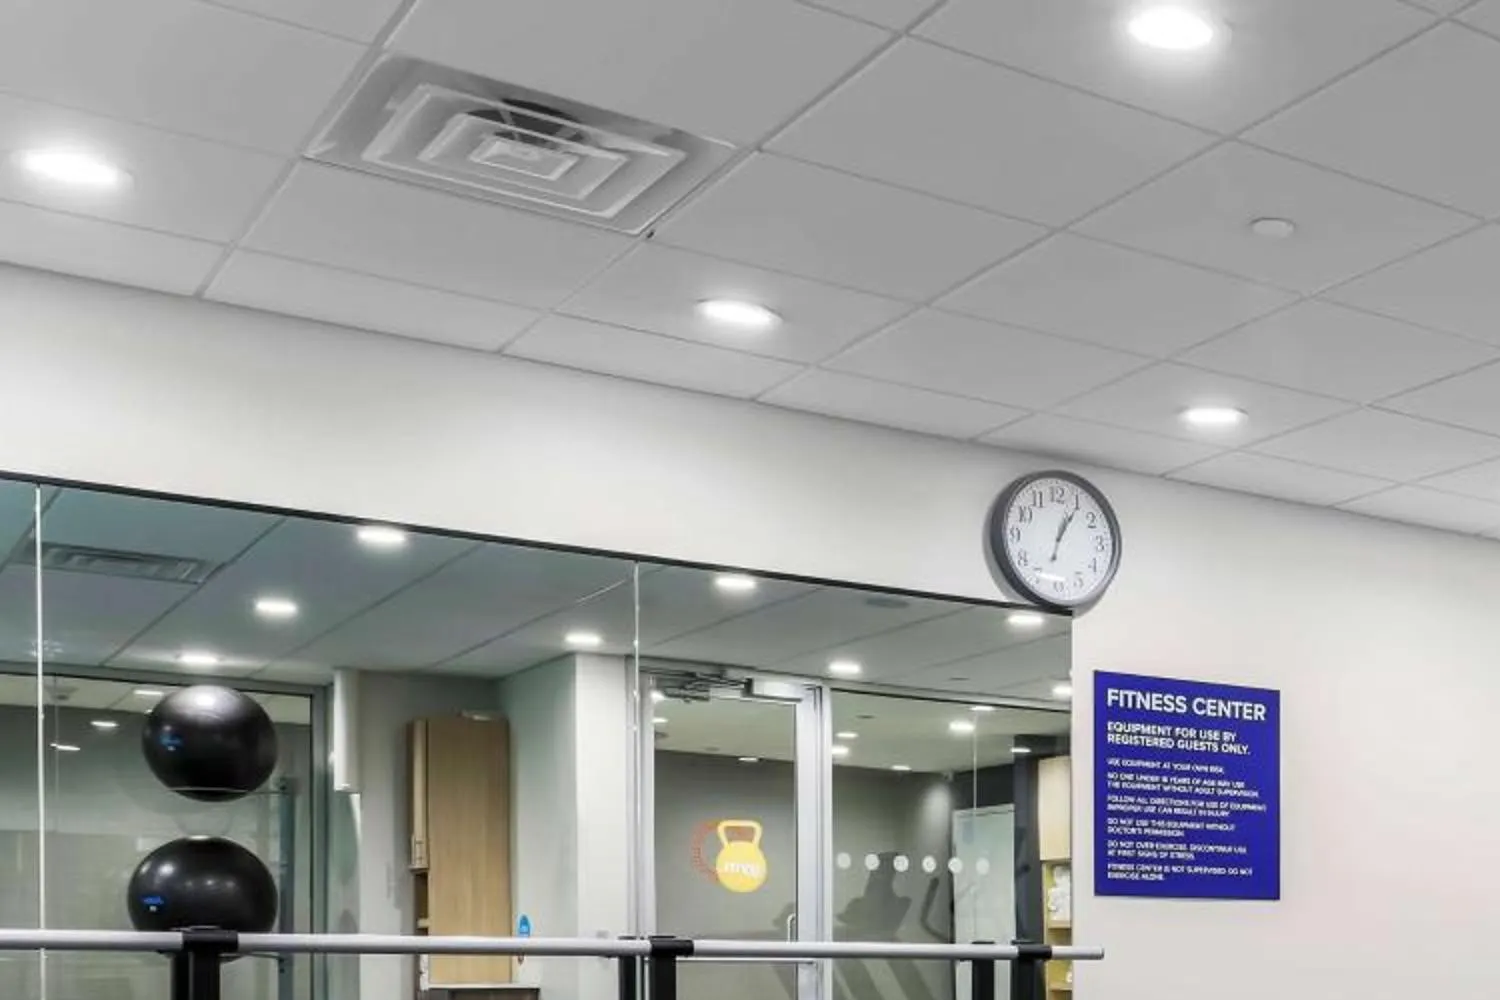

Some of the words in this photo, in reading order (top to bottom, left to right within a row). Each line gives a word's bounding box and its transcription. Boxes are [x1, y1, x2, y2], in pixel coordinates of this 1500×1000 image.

[1032, 490, 1044, 508] 11
[1049, 487, 1065, 504] 12
[1019, 506, 1032, 523] 10
[1086, 512, 1097, 528] 2
[1095, 536, 1105, 552] 3
[1107, 687, 1186, 713] FITNESS
[1192, 697, 1266, 721] CENTER
[1107, 721, 1173, 736] EQUIPMENT
[1175, 727, 1197, 738] FOR
[1199, 729, 1220, 740] USE
[1222, 731, 1236, 742] BY
[1107, 733, 1174, 749] REGISTERED
[1177, 739, 1218, 752] GUESTS
[1221, 743, 1251, 755] ONLY.
